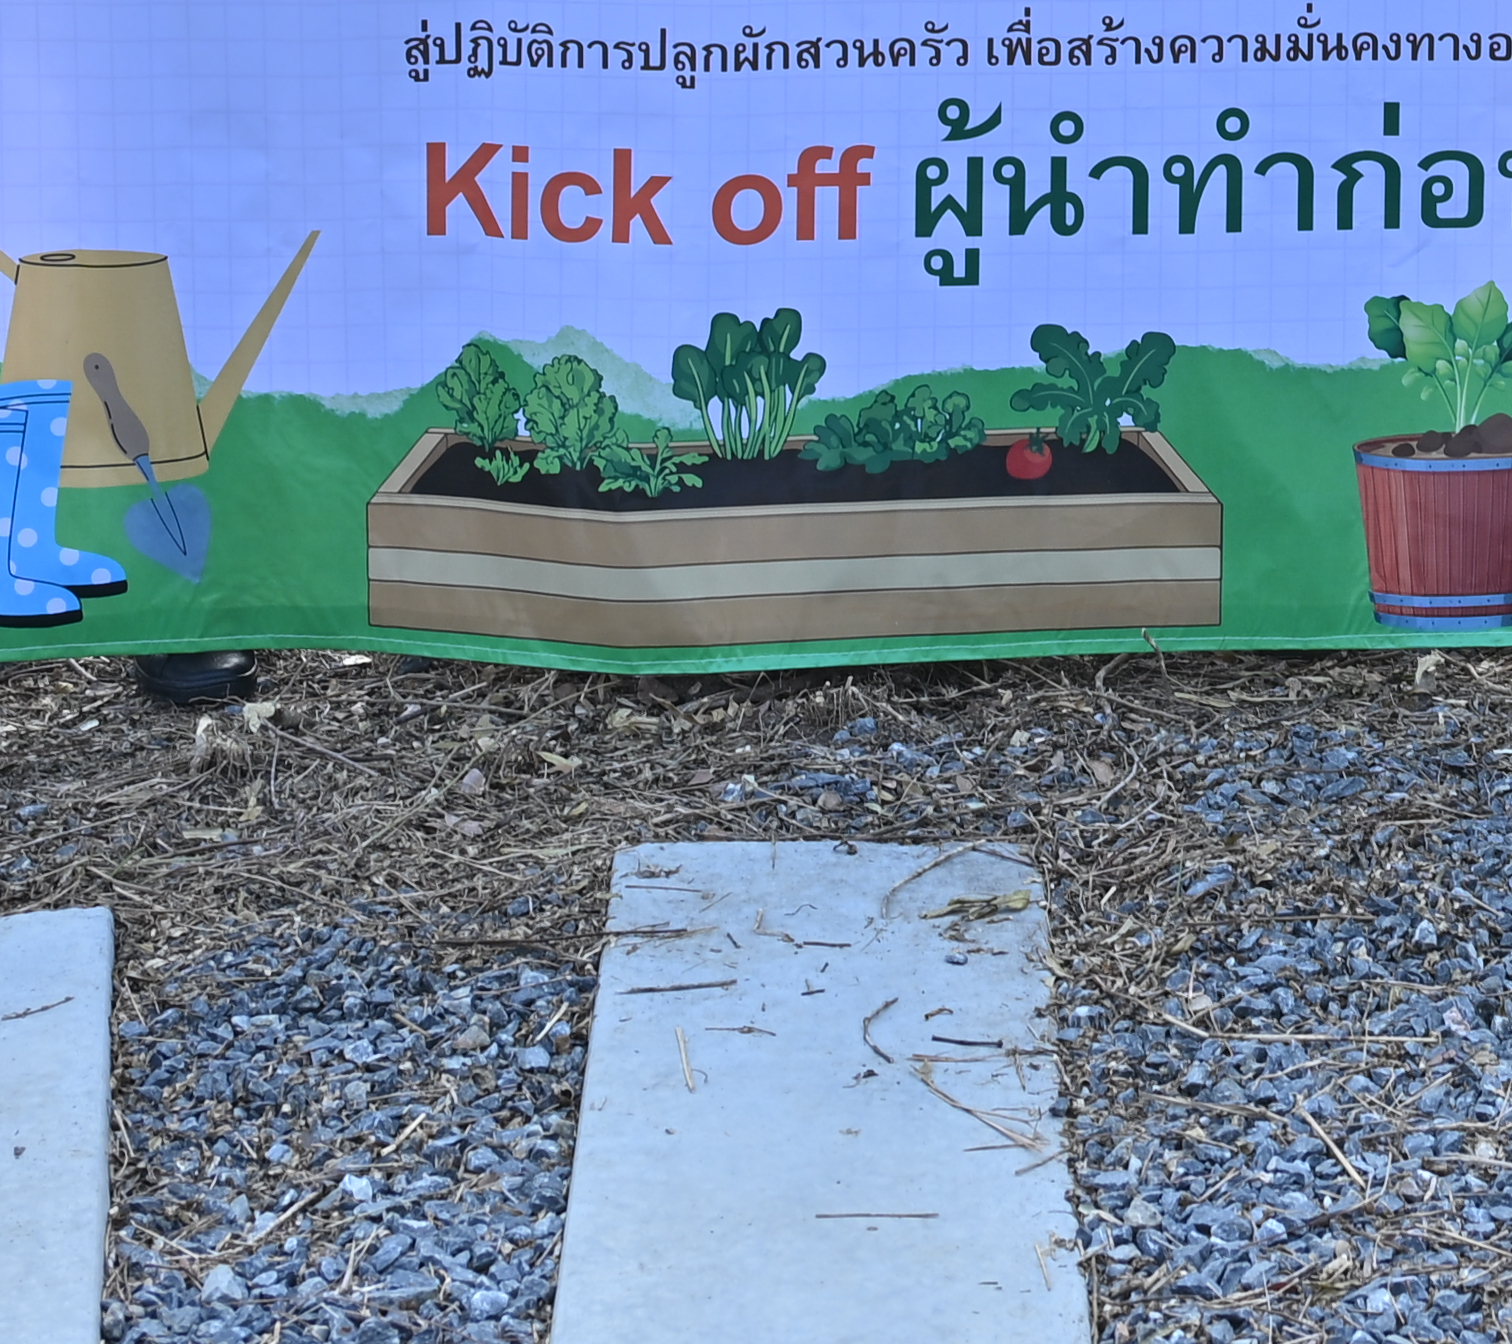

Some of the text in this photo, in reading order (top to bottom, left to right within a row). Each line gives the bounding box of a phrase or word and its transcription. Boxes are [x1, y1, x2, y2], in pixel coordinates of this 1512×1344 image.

[403, 19, 969, 90] สู่ปฏิบัติการปลูกผักสวนครัว
[425, 141, 673, 246] Kick
[711, 144, 876, 246] off
